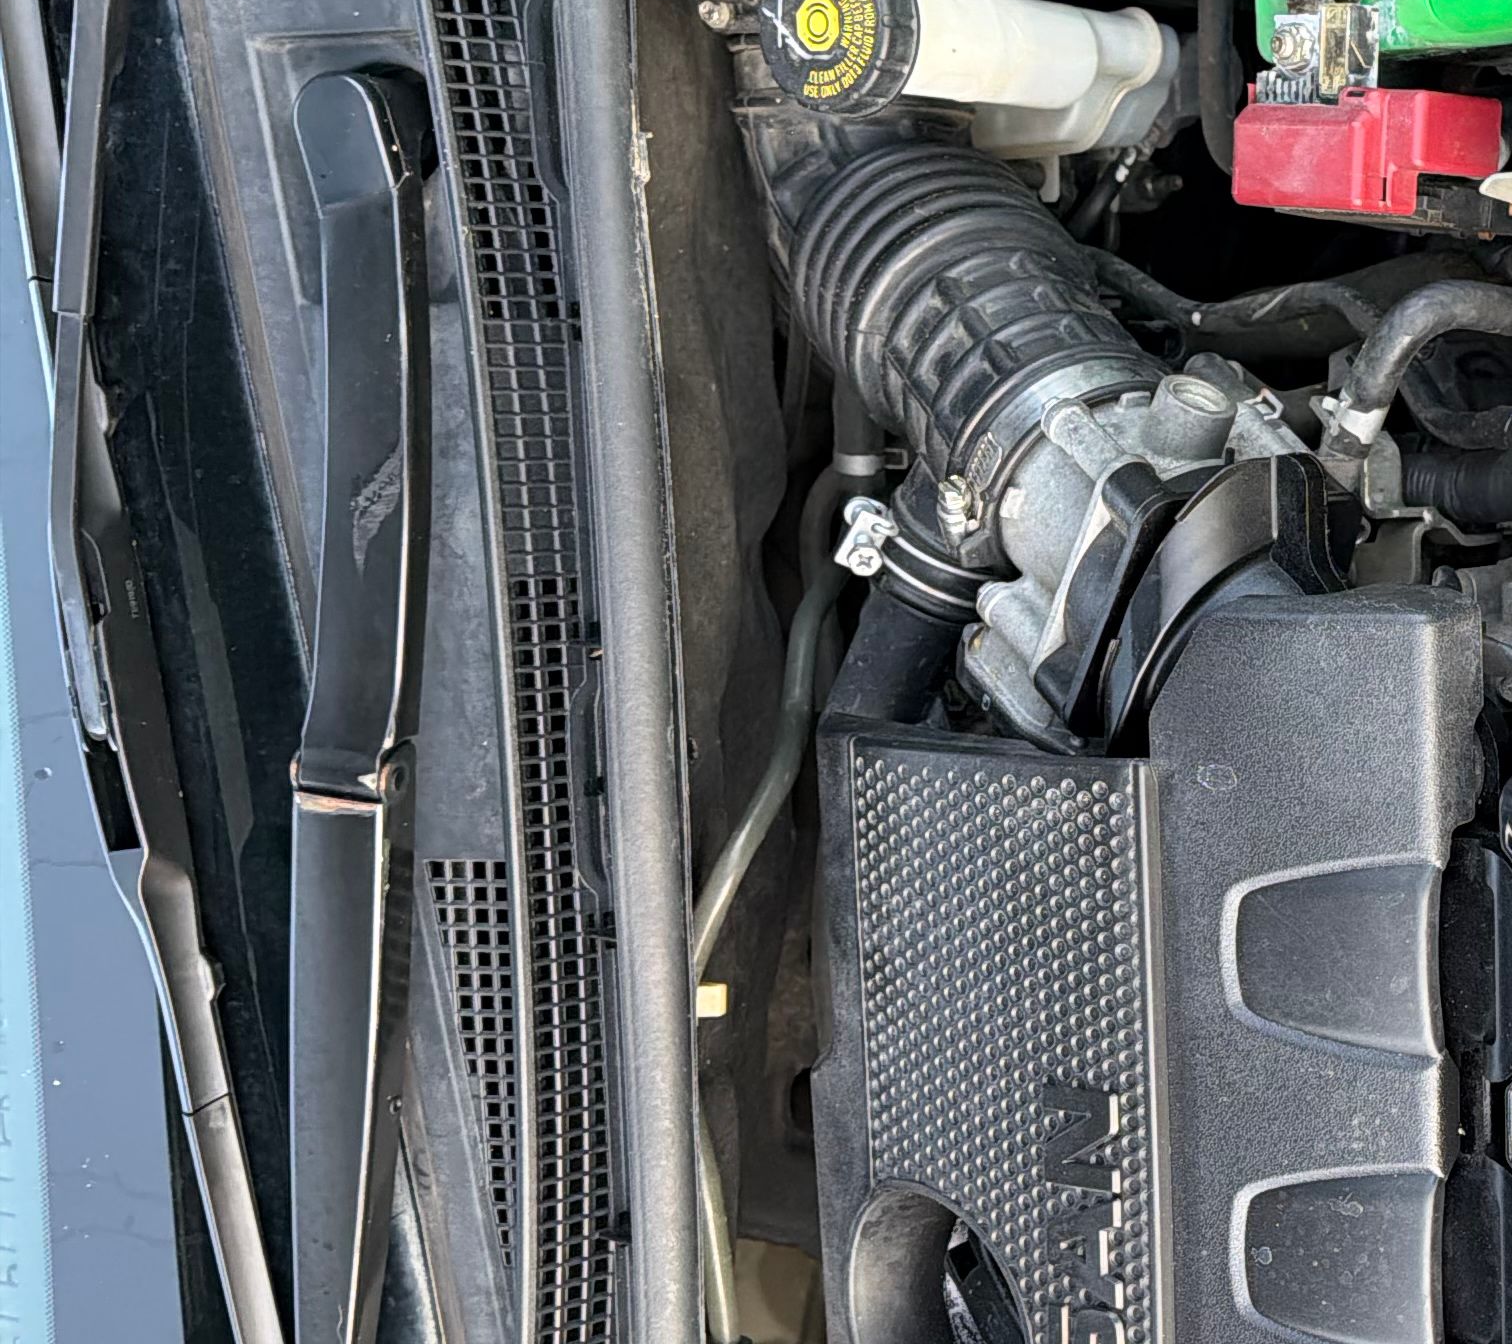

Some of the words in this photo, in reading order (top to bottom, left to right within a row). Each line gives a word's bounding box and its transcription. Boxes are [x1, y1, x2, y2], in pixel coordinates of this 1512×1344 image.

[862, 3, 875, 34] FROM
[809, 65, 836, 84] CLEAN
[833, 45, 860, 77] FILLER
[850, 23, 864, 45] CAP
[857, 35, 875, 66] FLUID
[803, 84, 820, 98] USE
[820, 81, 843, 98] ONLY
